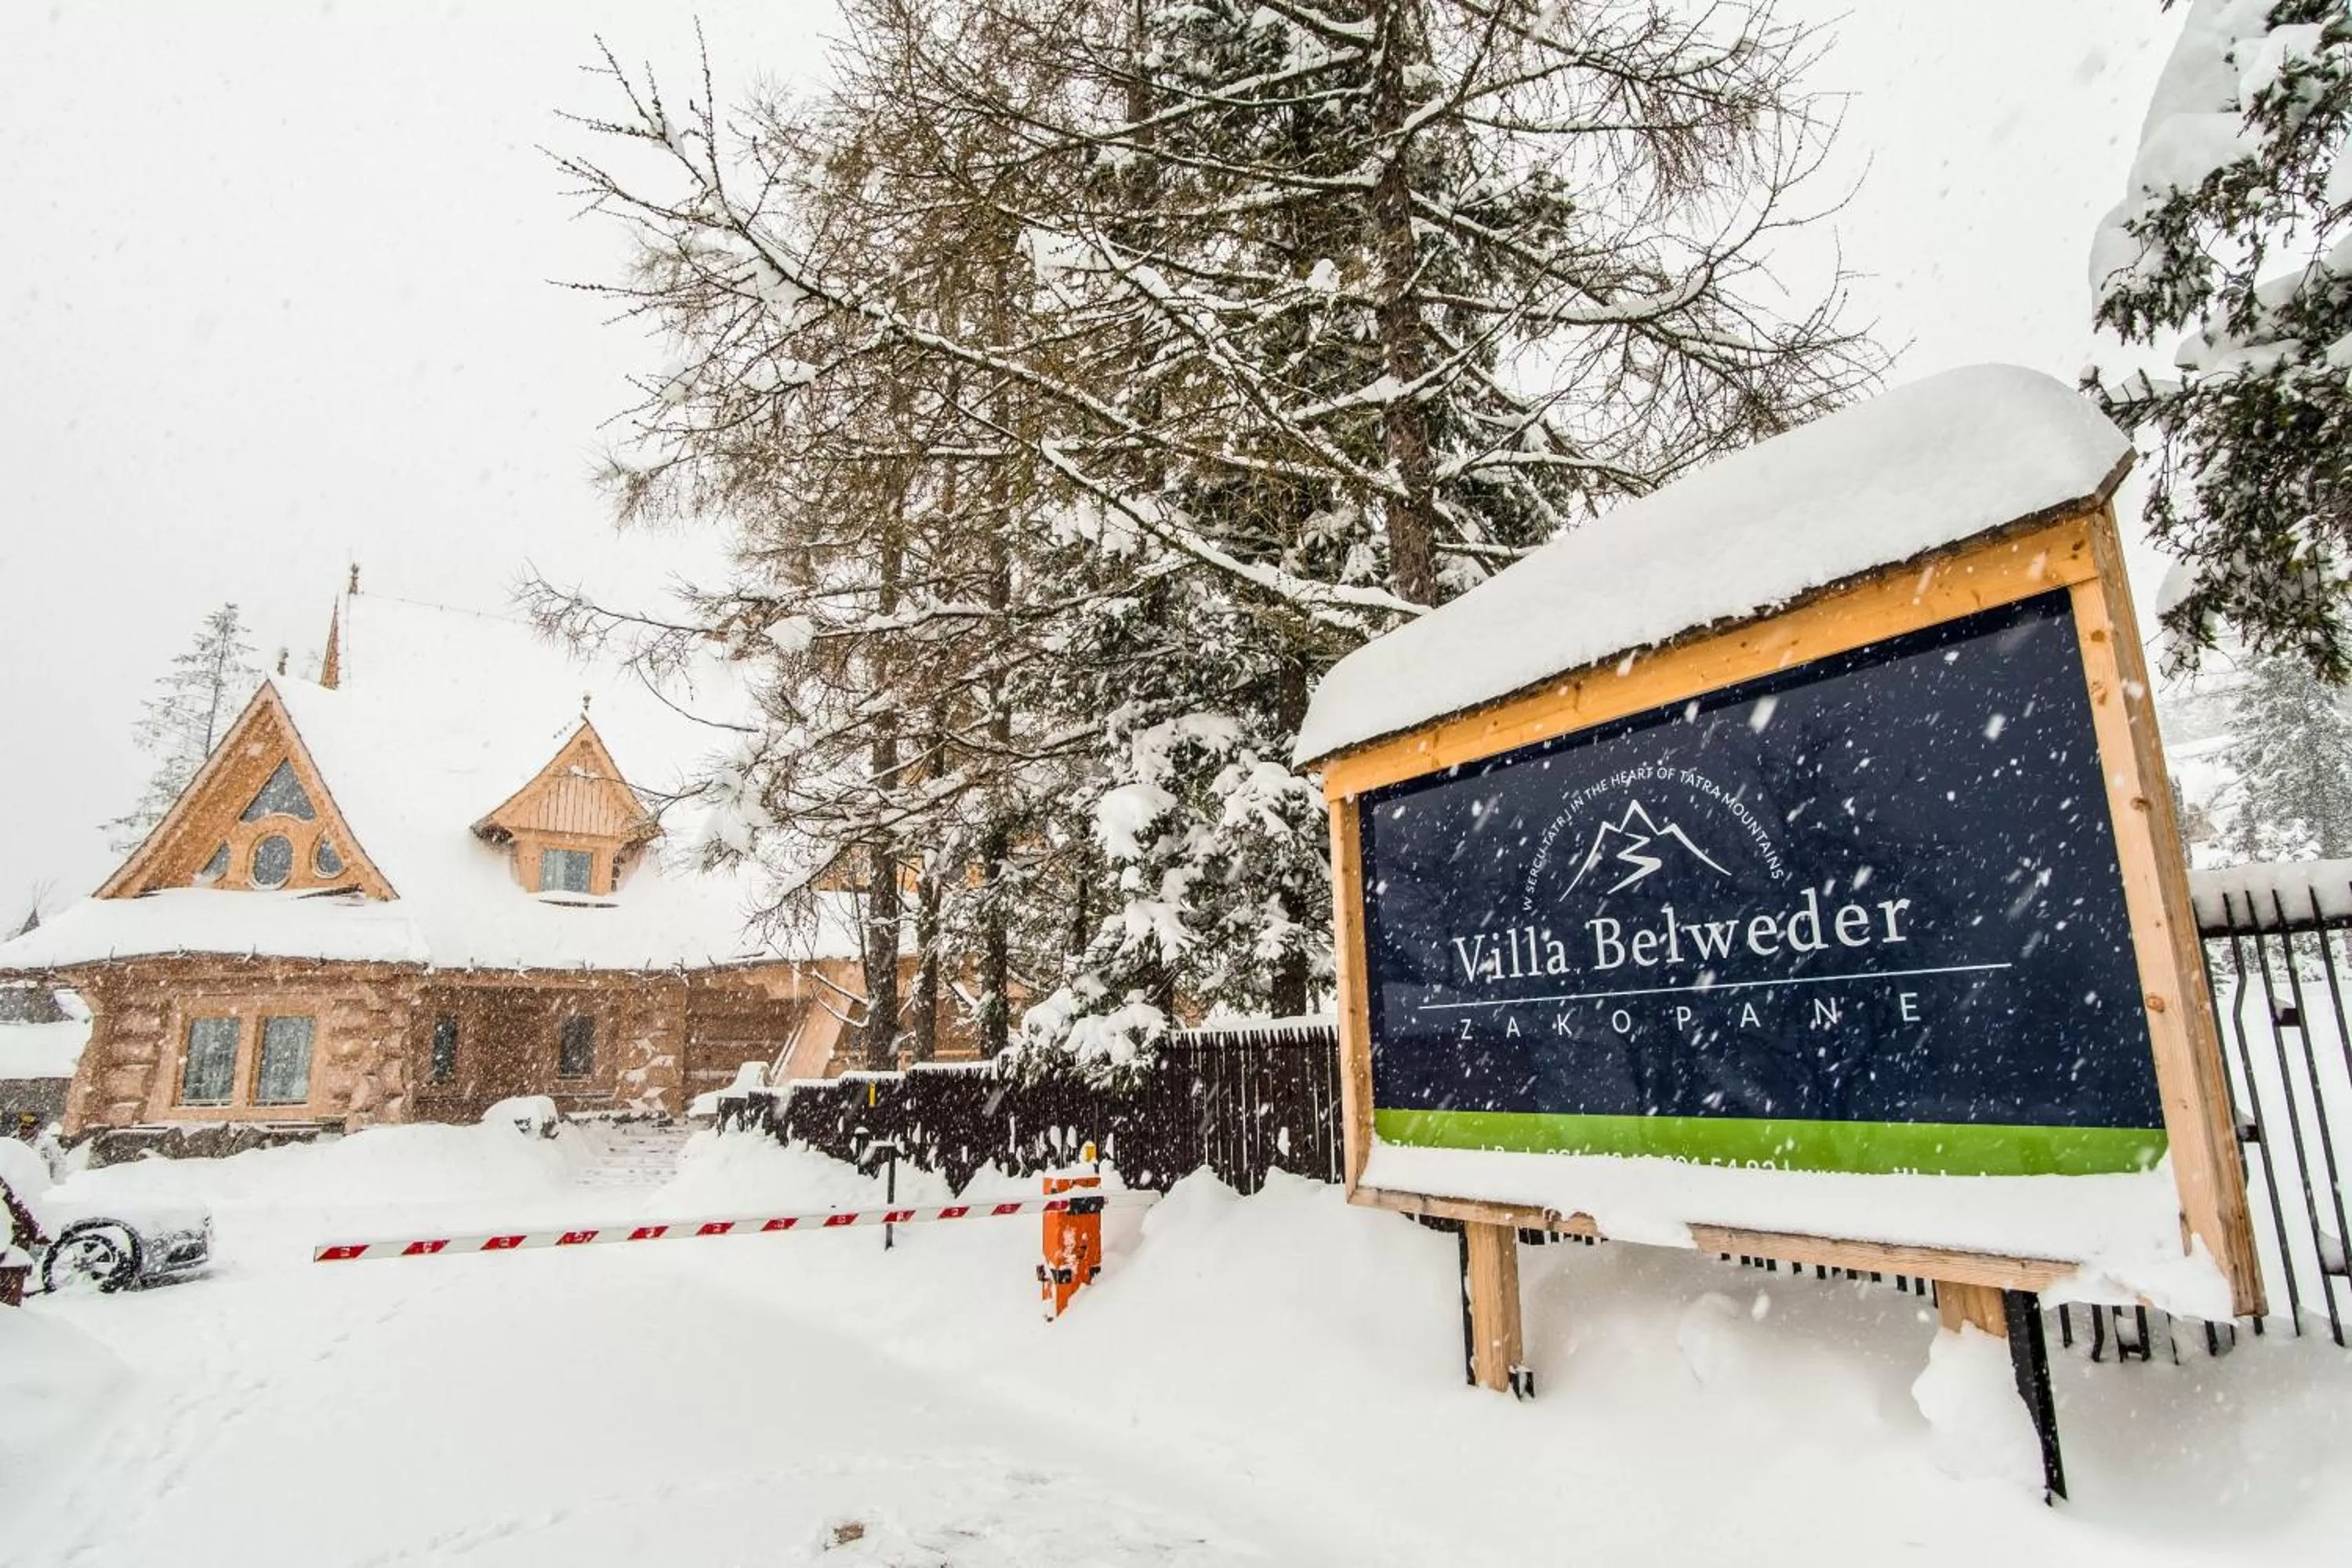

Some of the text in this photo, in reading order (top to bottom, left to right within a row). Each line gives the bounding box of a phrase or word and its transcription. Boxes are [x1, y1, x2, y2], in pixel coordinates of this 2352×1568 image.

[1523, 897, 1534, 911] W
[1570, 796, 1585, 813] IN
[1584, 779, 1608, 800] THE
[1611, 766, 1654, 785] HEART
[1657, 767, 1676, 780] OF
[1680, 769, 1721, 799] TATRA
[1721, 792, 1784, 880] MOUNTAINS
[1451, 887, 1911, 984] Villa Belweder
[1460, 992, 1921, 1040] ZAKOPANE
